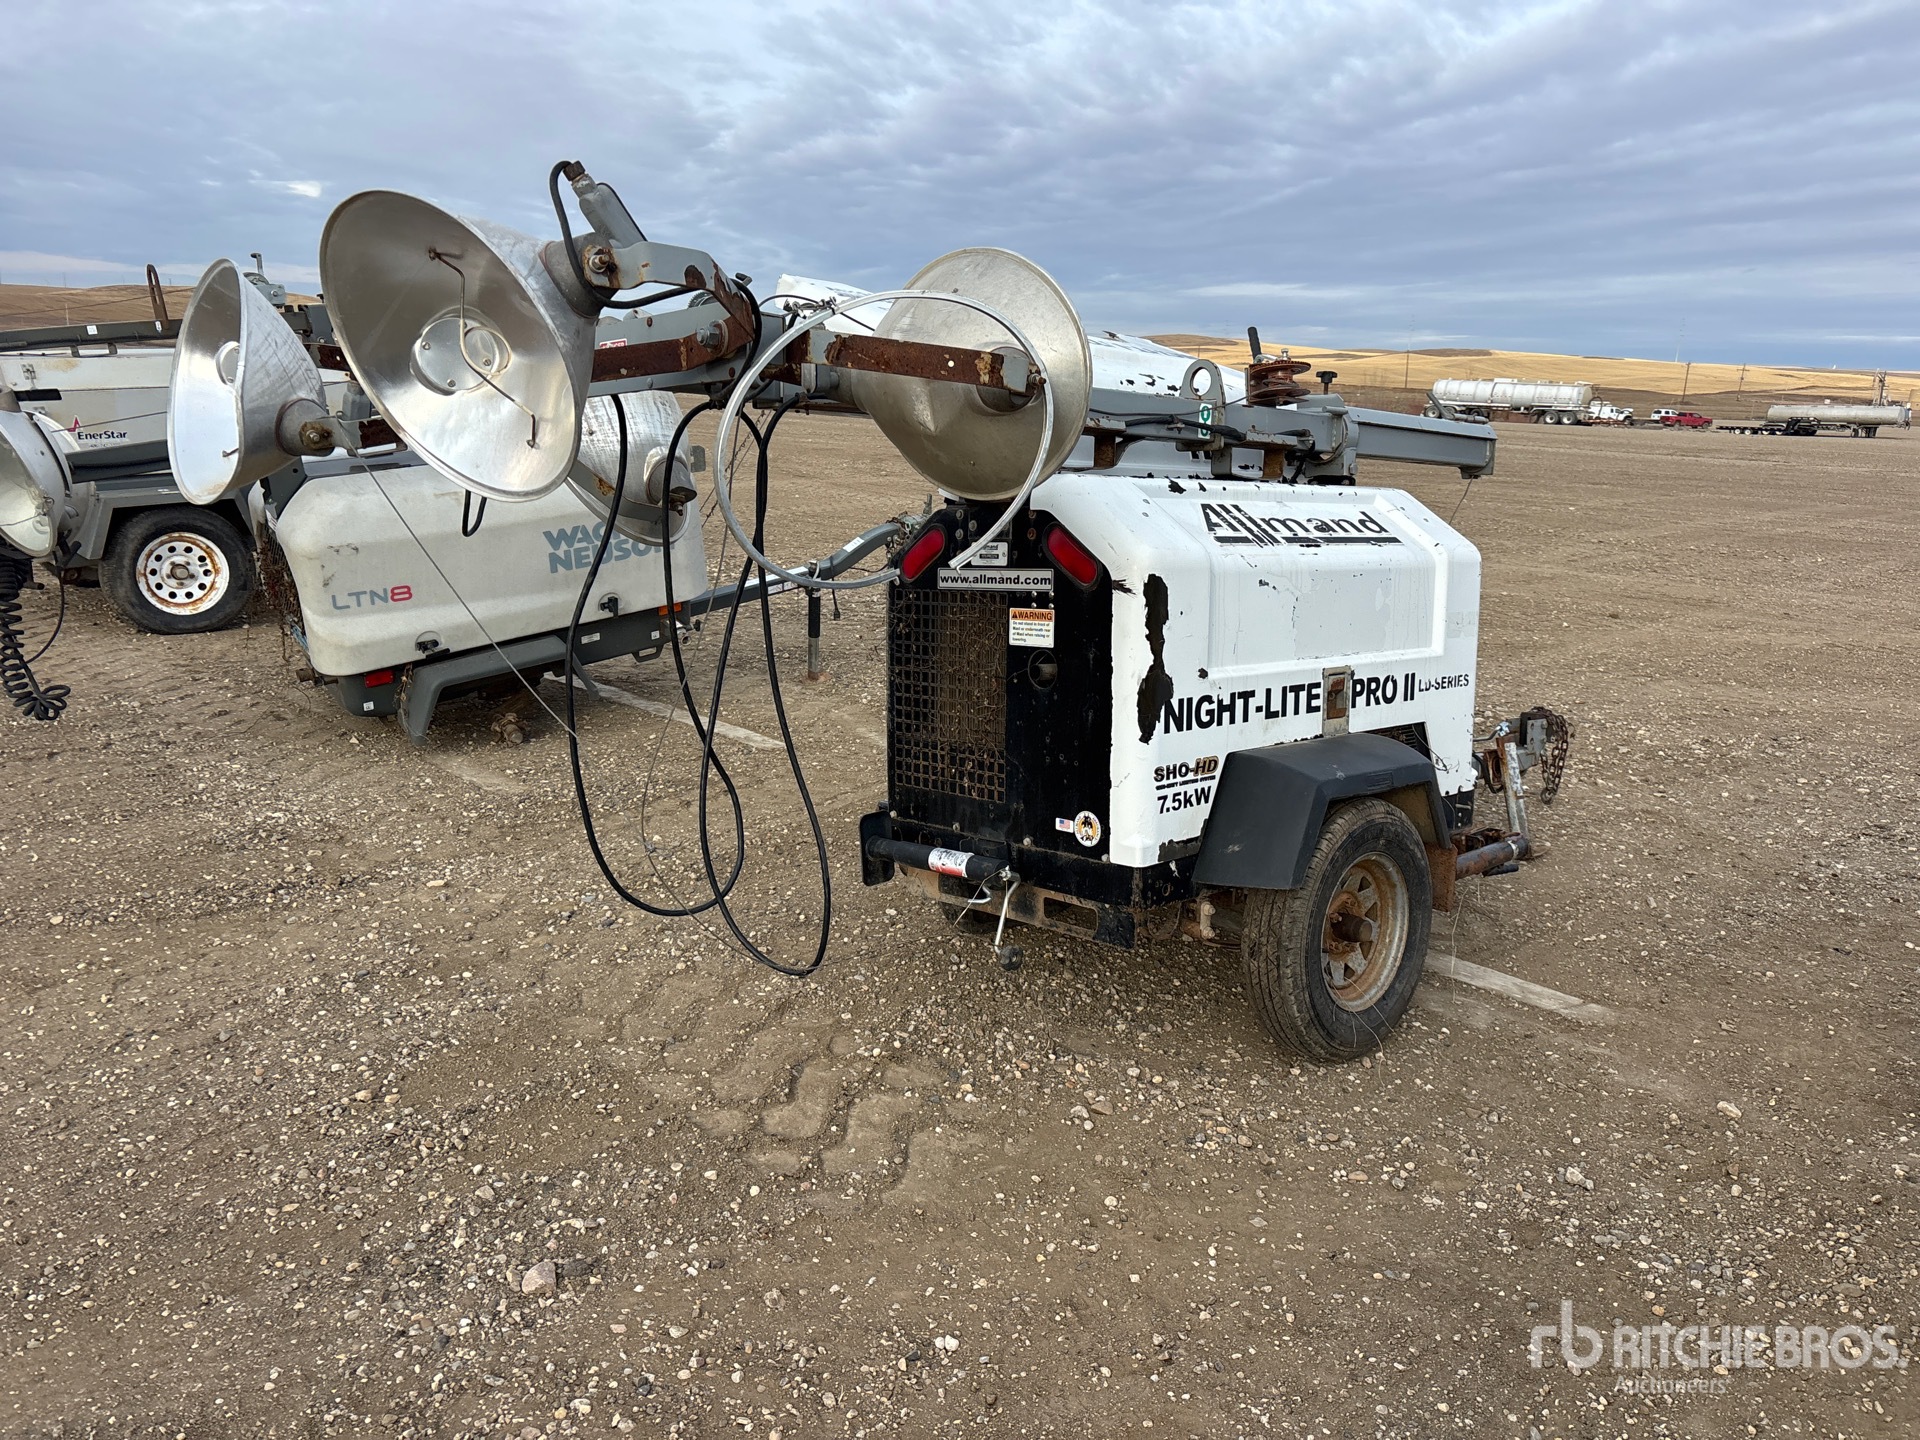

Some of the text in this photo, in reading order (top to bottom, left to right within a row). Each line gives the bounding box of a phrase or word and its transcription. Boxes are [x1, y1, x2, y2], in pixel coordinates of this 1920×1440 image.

[77, 430, 128, 440] EnerStar
[1200, 503, 1390, 548] Allmand
[940, 574, 1051, 585] www.allmand.com
[331, 585, 414, 611] LTN8
[1017, 611, 1052, 620] WARNING
[1418, 673, 1470, 693] LD-SERIES
[1163, 672, 1416, 734] NIGHT-LITE PRO II
[1153, 756, 1219, 782] SHO-HD
[1157, 785, 1212, 815] 7.5kW
